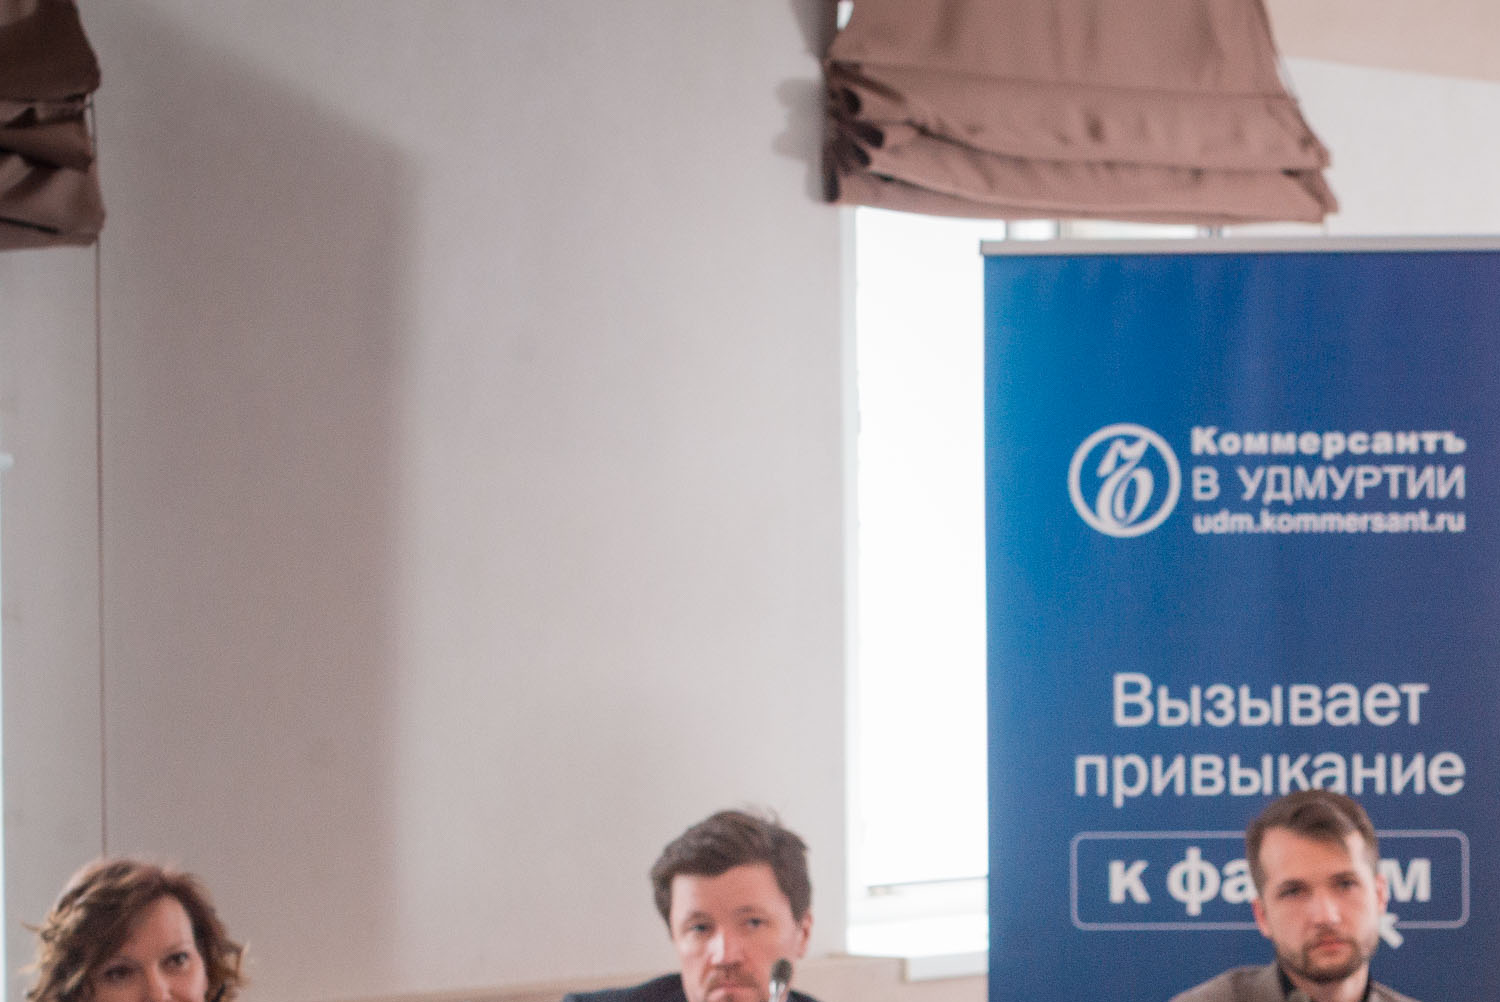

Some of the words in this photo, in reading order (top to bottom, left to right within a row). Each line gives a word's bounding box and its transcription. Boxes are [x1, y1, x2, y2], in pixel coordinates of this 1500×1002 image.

[1191, 426, 1466, 460] Коммерсантъ
[1192, 466, 1220, 501] В
[1237, 465, 1466, 504] УДМУРТИИ
[1193, 509, 1466, 534] udm.kommersant.ru
[1113, 672, 1430, 727] Вызывает
[1075, 752, 1466, 807] привыкание
[1108, 860, 1151, 904] к
[1166, 846, 1431, 916] фам
